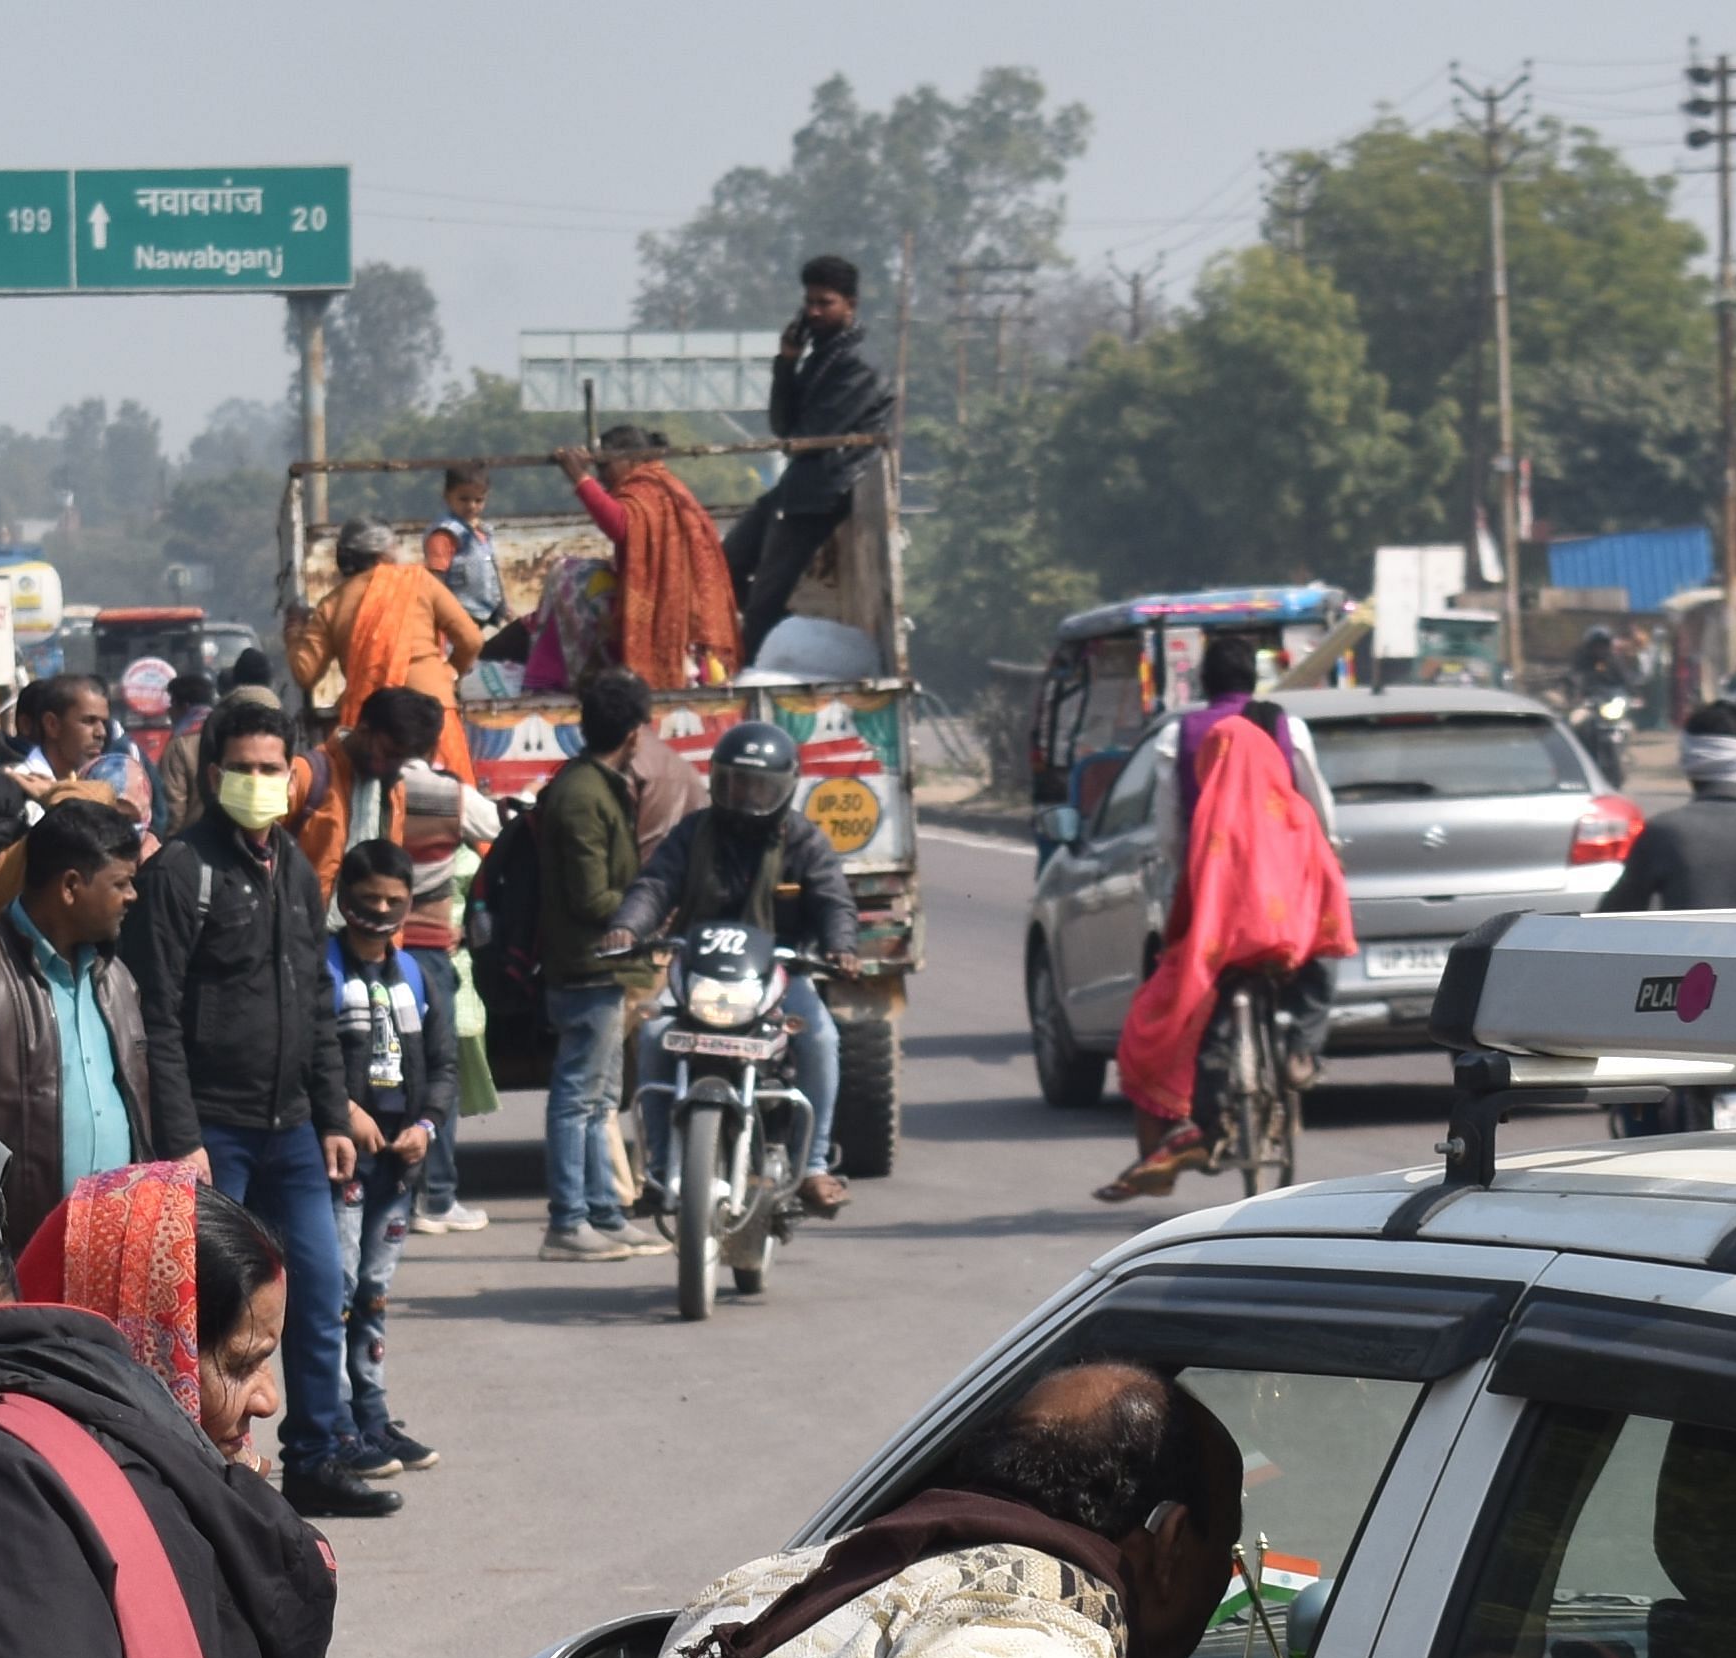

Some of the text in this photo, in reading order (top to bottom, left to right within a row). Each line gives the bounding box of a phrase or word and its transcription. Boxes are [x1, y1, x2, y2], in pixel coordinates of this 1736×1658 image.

[7, 206, 52, 233] 199
[290, 205, 328, 232] 20
[134, 244, 284, 279] Nawabganj
[1638, 982, 1681, 1009] PLA
